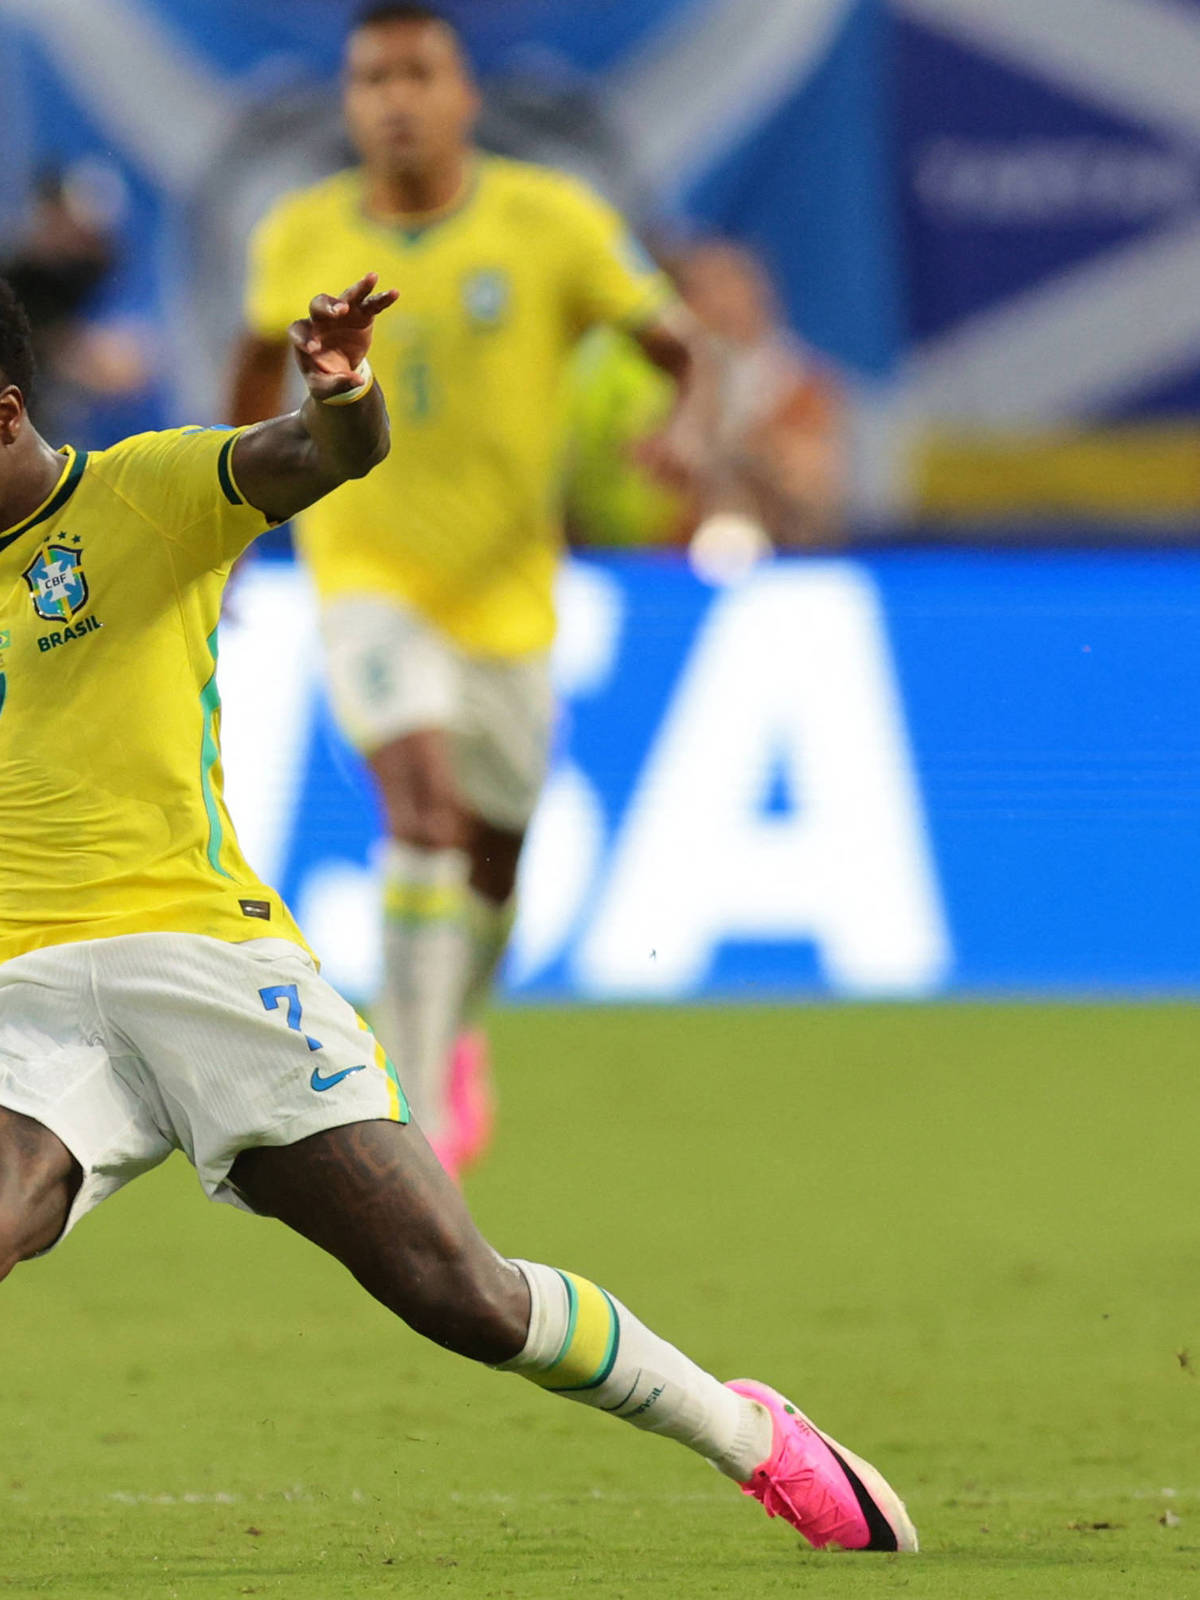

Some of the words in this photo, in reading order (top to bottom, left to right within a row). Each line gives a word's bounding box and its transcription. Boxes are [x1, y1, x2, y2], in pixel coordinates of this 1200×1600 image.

[44, 573, 67, 590] CBF
[37, 615, 101, 653] BRASIL
[258, 984, 323, 1052] 7
